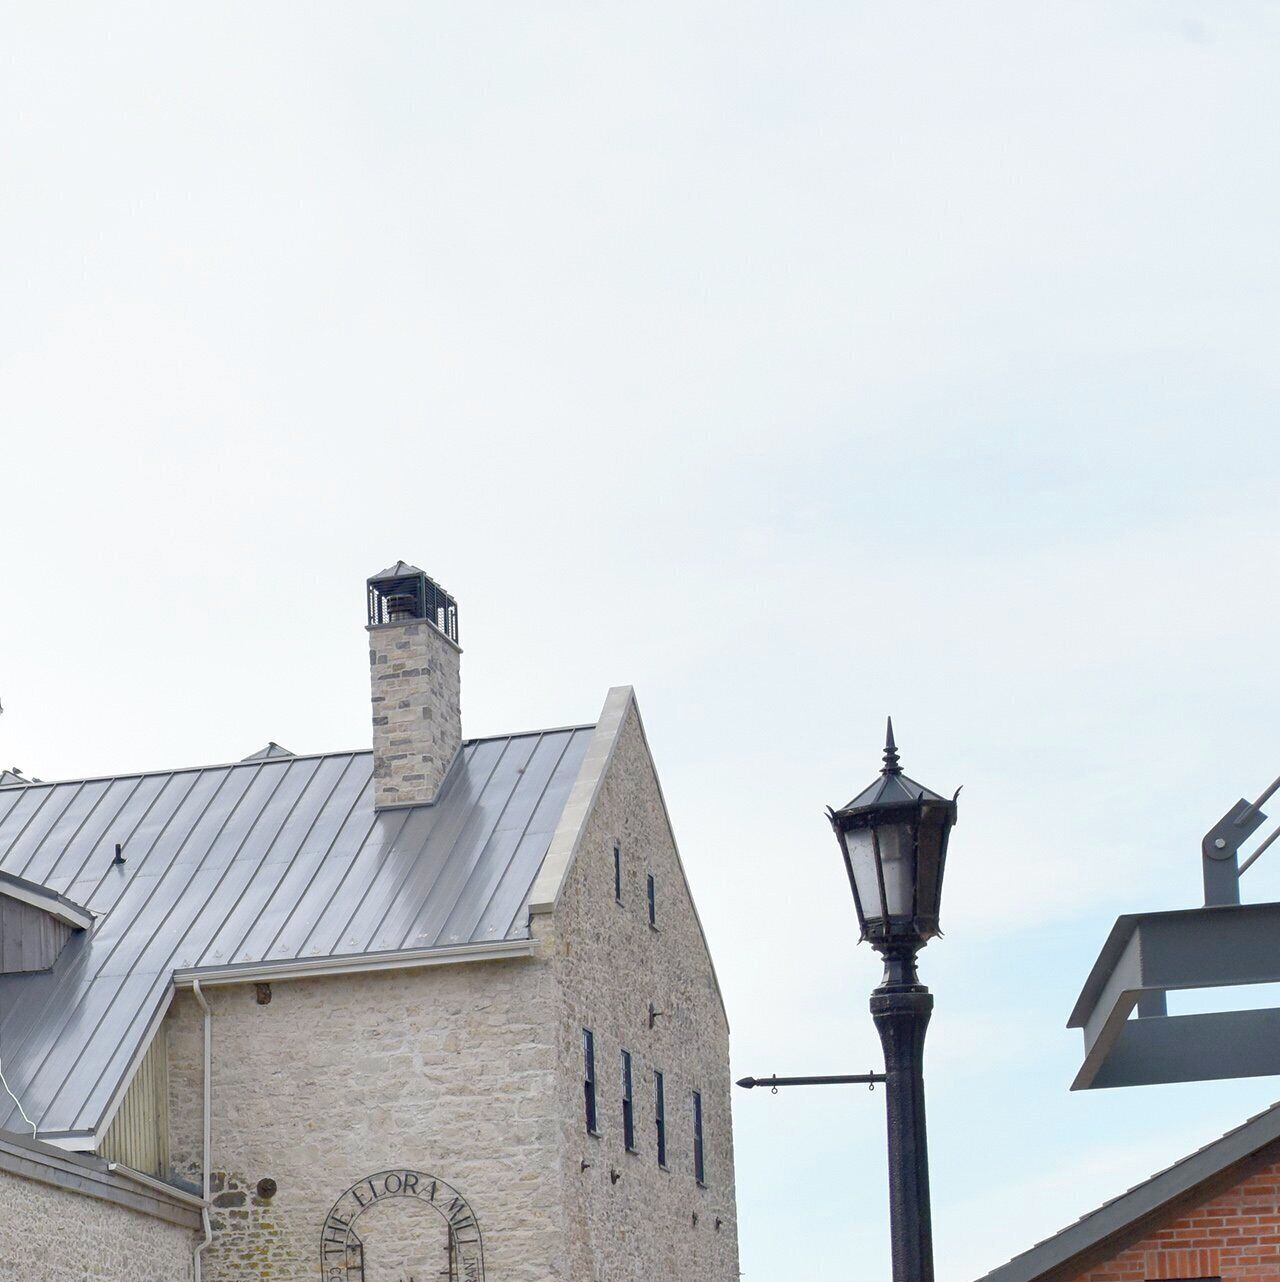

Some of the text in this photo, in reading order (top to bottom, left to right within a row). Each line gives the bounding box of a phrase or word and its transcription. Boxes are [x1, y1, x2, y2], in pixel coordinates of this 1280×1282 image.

[324, 1174, 478, 1260] THE ELORA MILL
